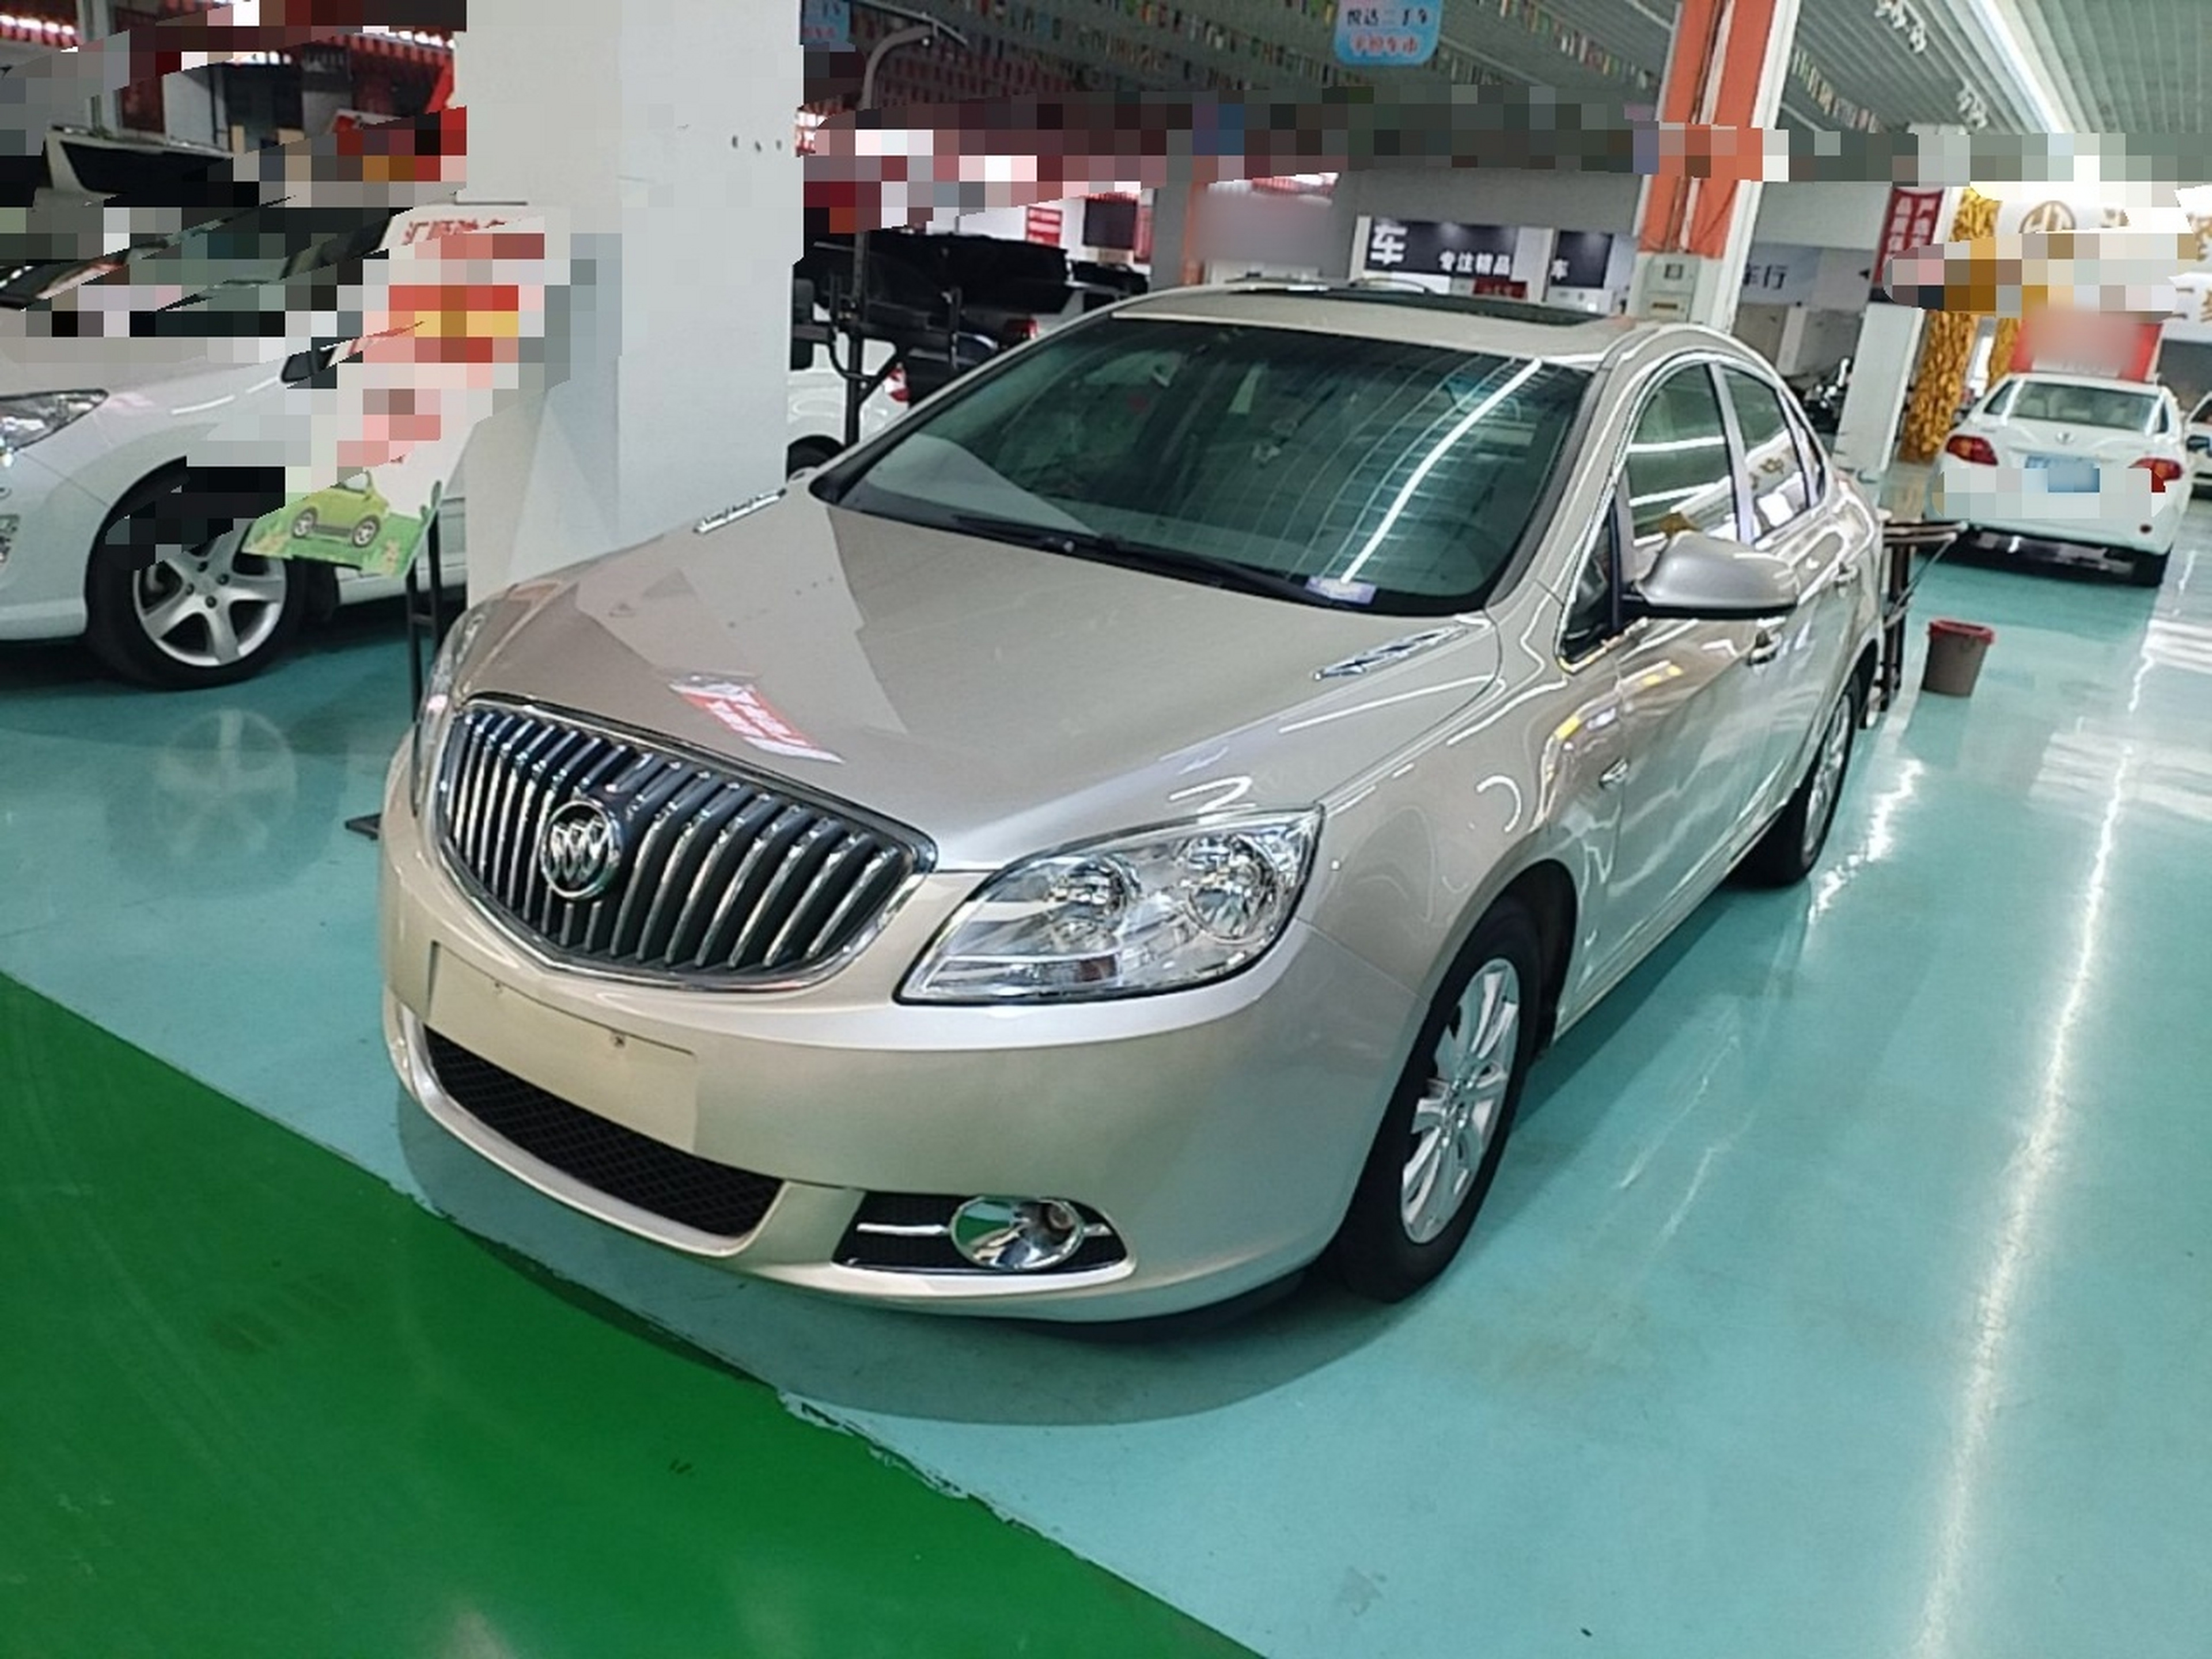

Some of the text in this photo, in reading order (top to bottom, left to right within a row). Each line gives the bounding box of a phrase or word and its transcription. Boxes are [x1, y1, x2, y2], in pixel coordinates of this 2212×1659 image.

[1370, 224, 1407, 265] 车
[1440, 252, 1511, 275] 专注精品
